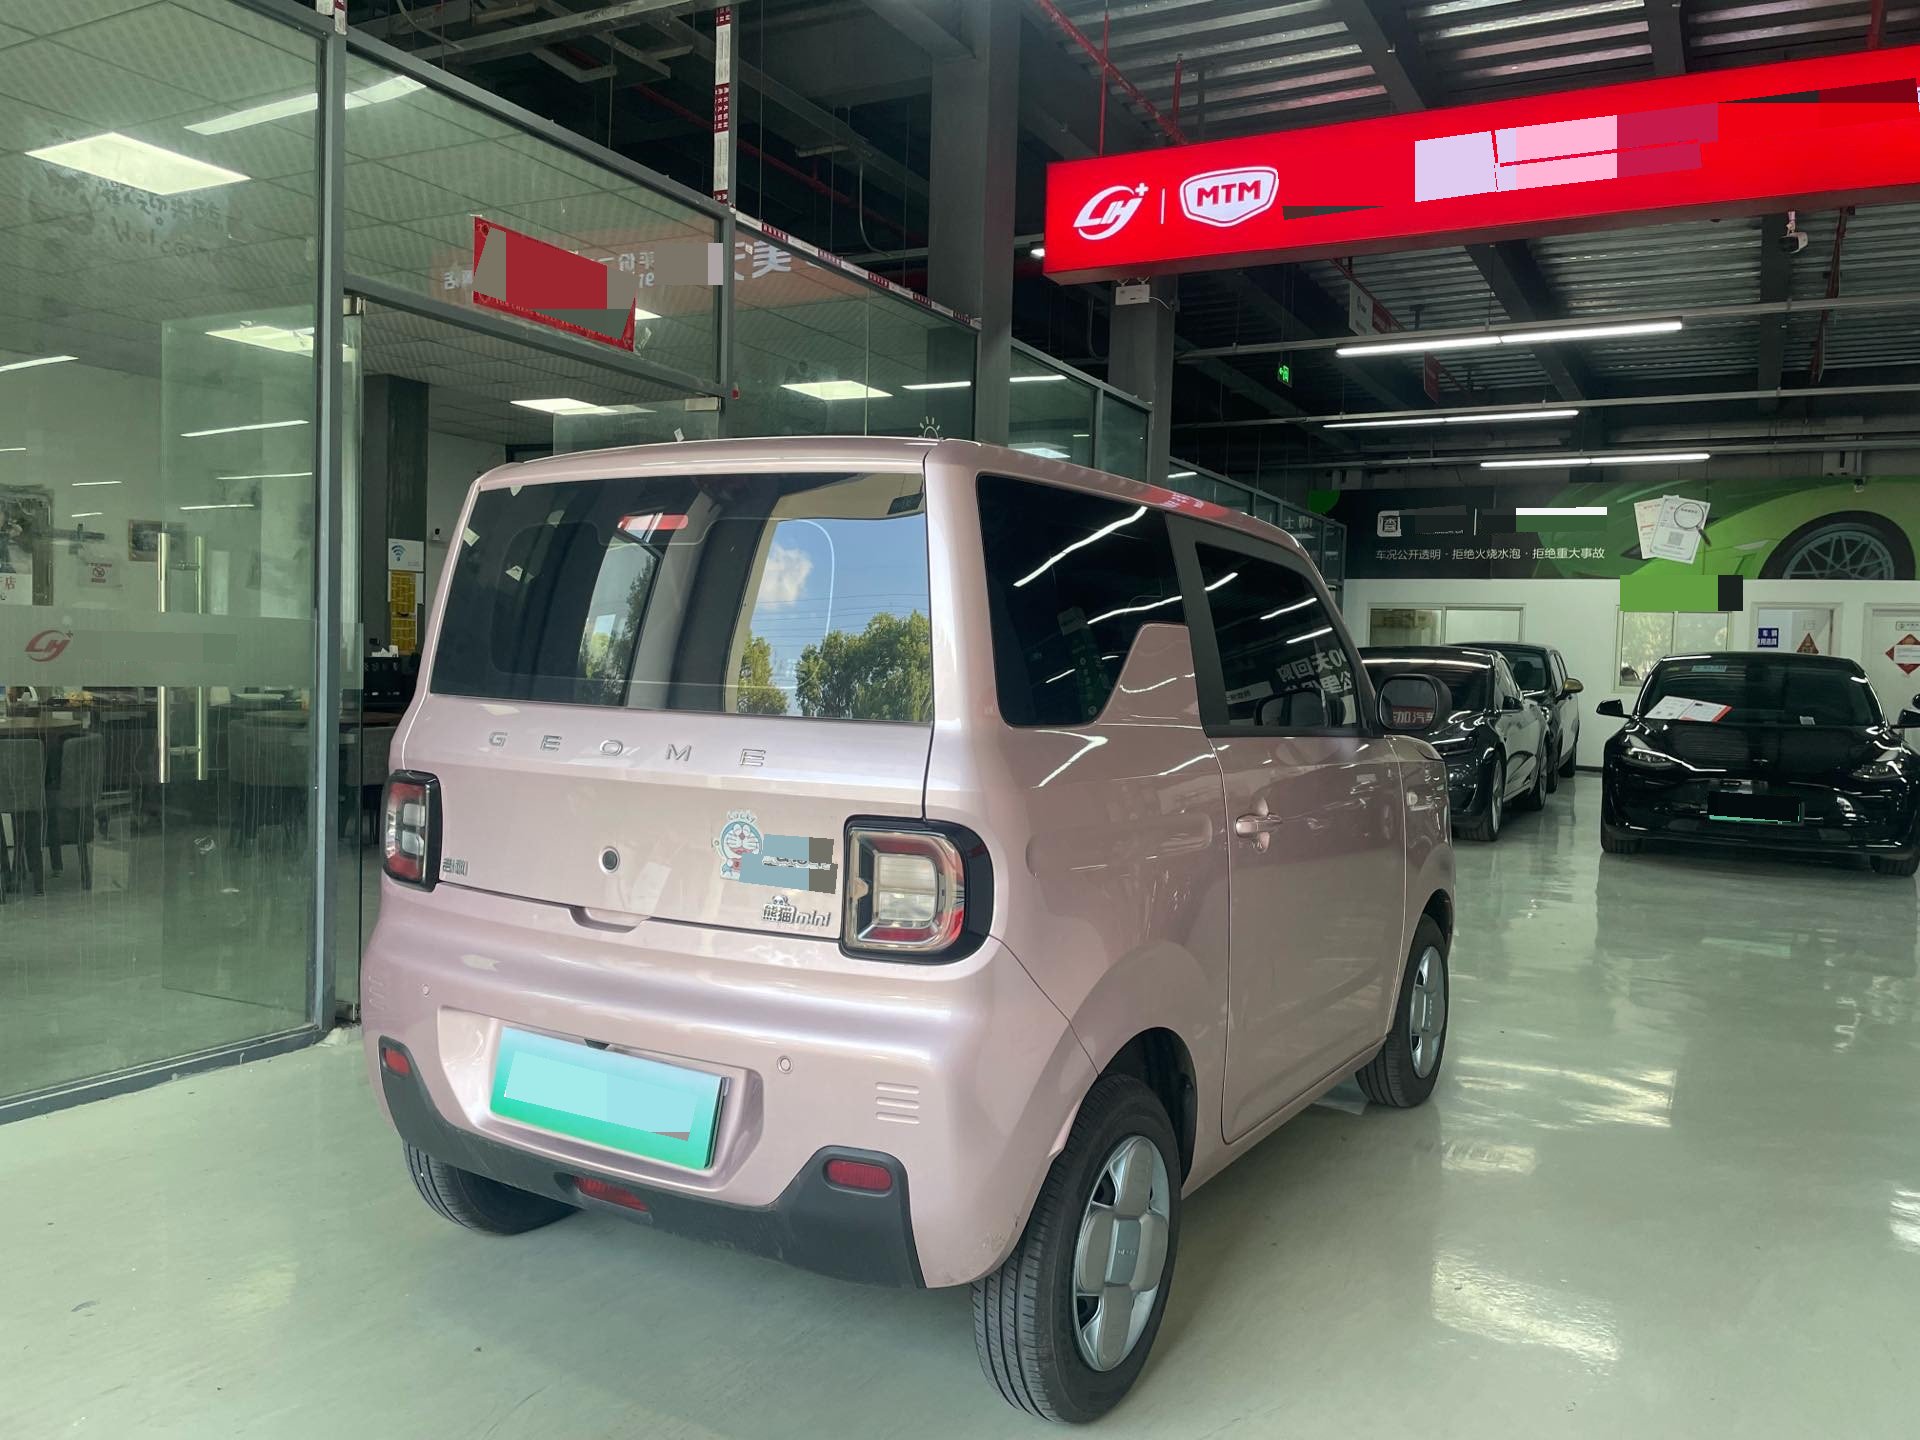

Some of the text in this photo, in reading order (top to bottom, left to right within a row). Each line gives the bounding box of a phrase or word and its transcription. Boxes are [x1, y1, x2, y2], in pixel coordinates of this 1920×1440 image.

[1196, 179, 1261, 207] MTM
[1376, 547, 1605, 560] 车况公开透明 拒绝火烧水泡 拒绝重大事故
[488, 731, 767, 767] GEOME
